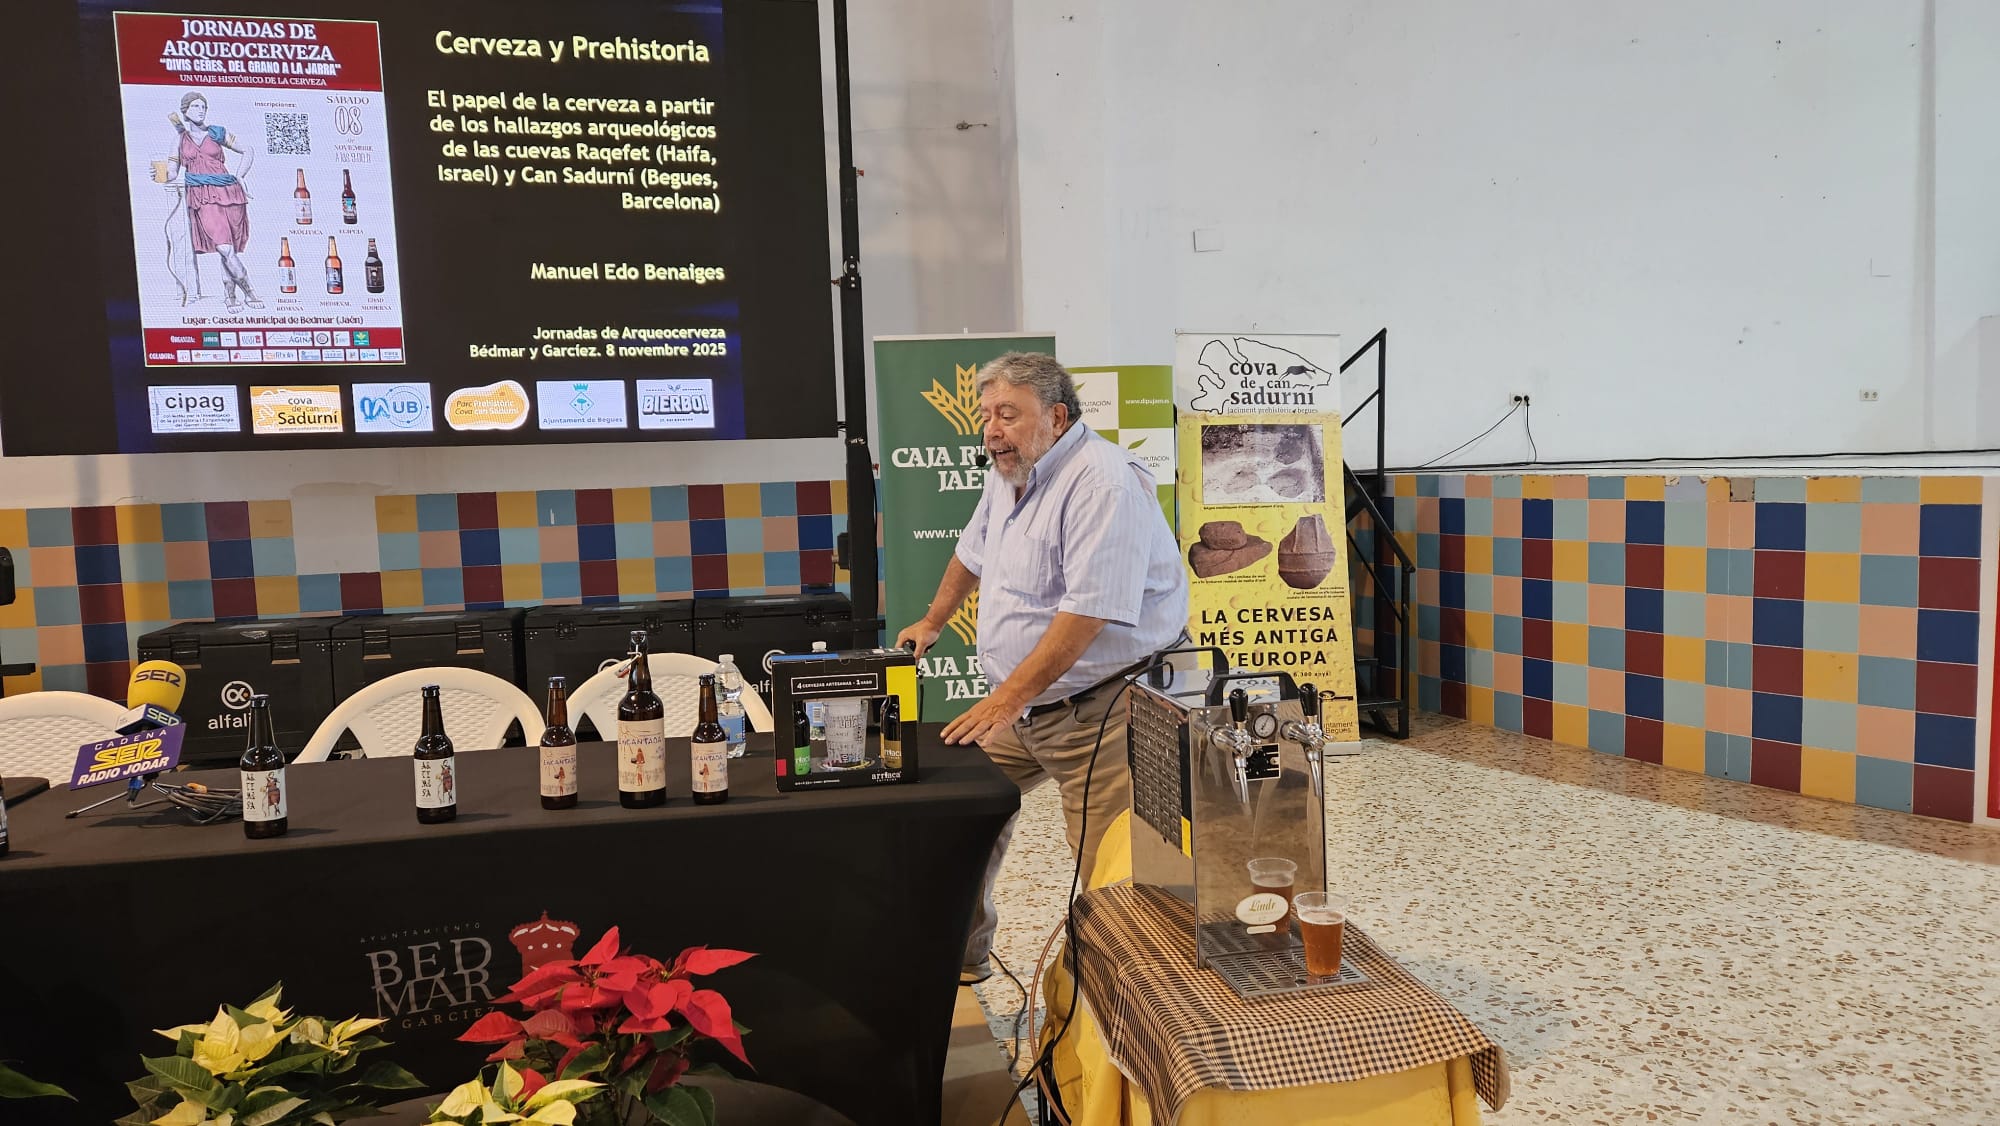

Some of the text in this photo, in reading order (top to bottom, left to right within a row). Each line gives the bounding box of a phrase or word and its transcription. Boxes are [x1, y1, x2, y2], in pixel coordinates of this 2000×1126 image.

[182, 19, 316, 40] JORNADAS DE
[162, 40, 335, 61] ARQUEOCERVEZA
[434, 30, 710, 62] Cerveza y Prehistoria
[228, 61, 246, 73] DEL
[248, 62, 280, 74] GRANO
[281, 62, 290, 74] A
[291, 63, 303, 75] LA
[179, 74, 192, 82] UN
[192, 75, 217, 83] VIAJE
[218, 75, 263, 84] HISTÓRICO
[264, 76, 278, 84] DE
[289, 77, 327, 86] CERVEZA
[326, 93, 370, 104] SÁBADO
[427, 90, 715, 117] El papel de la cerveza a partir
[334, 106, 363, 136] 08
[429, 114, 717, 141] de los hallazgos arqueológicos
[442, 140, 717, 166] de las cuevas Raqefet (Haifa,
[438, 165, 718, 190] Israel) y Can Sadurní (Begues,
[621, 193, 720, 213] Barcelona)
[530, 263, 725, 284] Manuel Edo Benaiges
[182, 316, 364, 326] Lugar: Caseta Municipal de Bedmar (Jaén)
[533, 326, 726, 342] Jornadas de Arqueocerveza
[469, 343, 727, 360] Bédmar y Garcíez. 8 novembre 2025
[1229, 362, 1278, 376] cova
[1240, 377, 1291, 389] de can
[165, 393, 224, 412] cipag
[1230, 386, 1315, 405] sadurní
[393, 401, 418, 413] UB
[278, 411, 338, 425] Sadurní
[598, 416, 624, 424] Begues
[891, 447, 955, 469] CAJA
[938, 466, 992, 492] JAÉ
[1202, 607, 1335, 624] LA CERVESA
[1200, 627, 1338, 646] MÉS ANTIGA
[916, 656, 961, 678] AJA
[1231, 651, 1327, 667] 'EUROPA
[134, 670, 181, 687] SER
[797, 680, 802, 689] 4
[945, 675, 991, 701] JAÉ
[94, 729, 167, 750] CADENA
[89, 738, 163, 772] SER
[77, 756, 170, 786] RADIO JODAR
[360, 922, 480, 944] AYUNTAMIENTO
[365, 937, 492, 990] BED
[373, 968, 497, 1020] MAR
